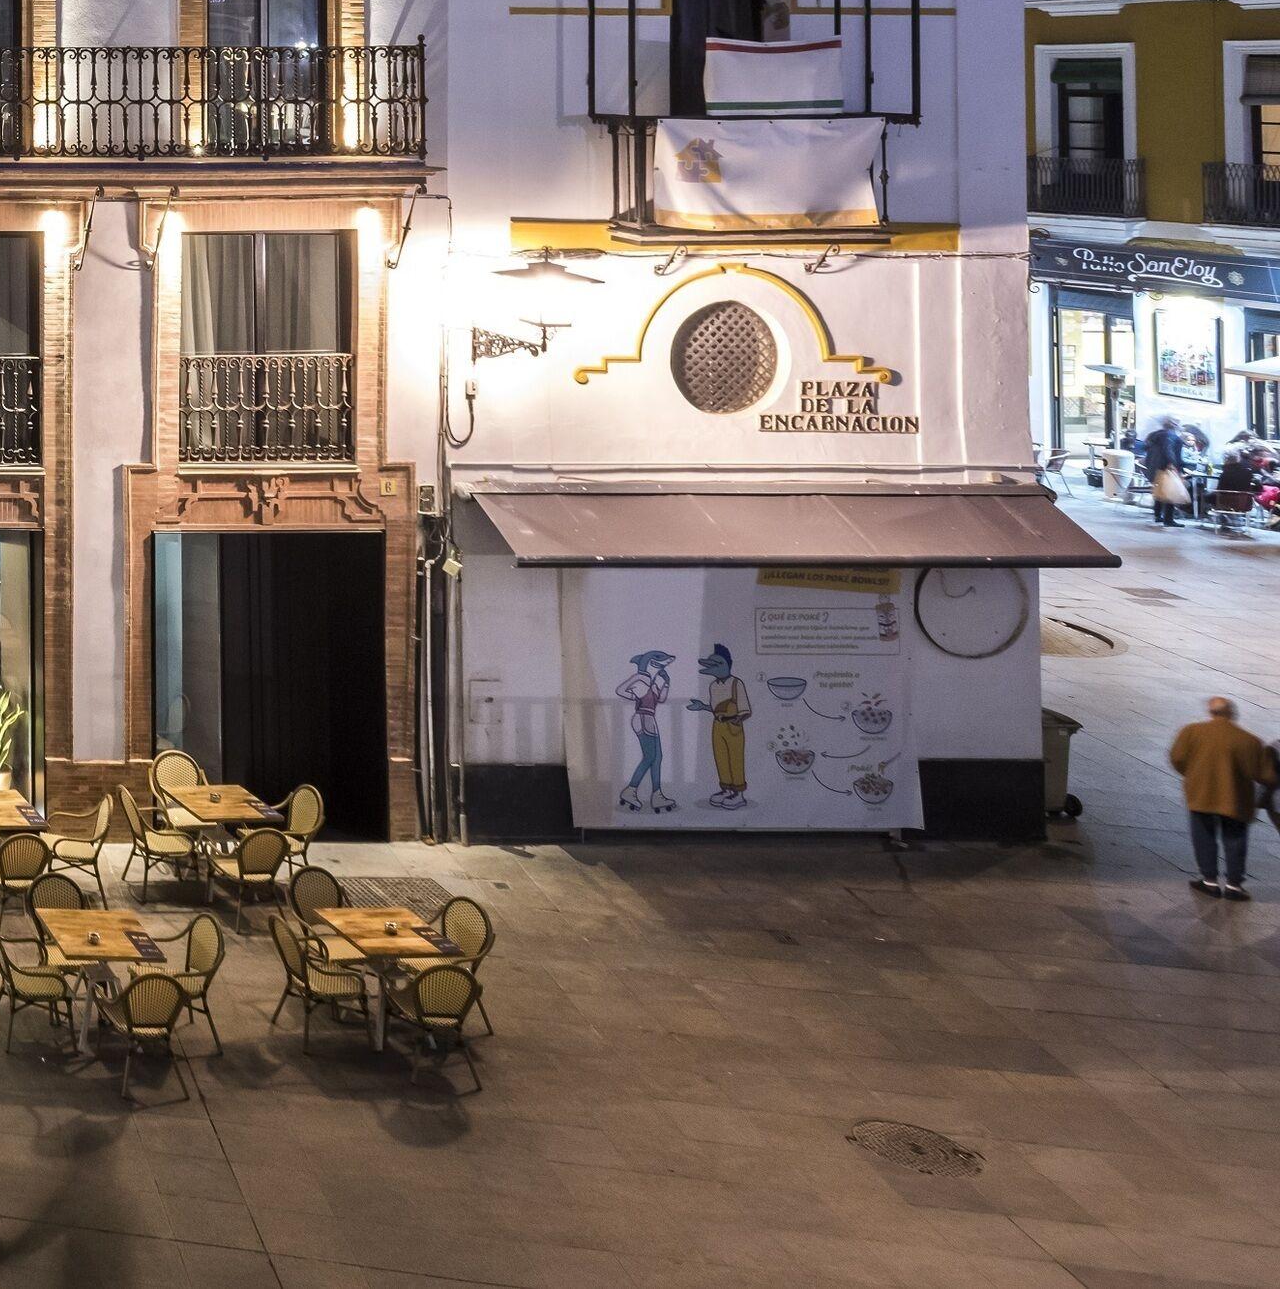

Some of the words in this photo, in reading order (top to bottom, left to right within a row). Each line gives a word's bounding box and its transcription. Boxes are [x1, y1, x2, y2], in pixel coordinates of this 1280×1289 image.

[1127, 253, 1170, 274] San
[1171, 257, 1217, 284] Eloy
[800, 381, 874, 397] PLAZA
[800, 398, 830, 413] DE
[847, 399, 874, 414] LA
[759, 415, 919, 432] ENCARNACION
